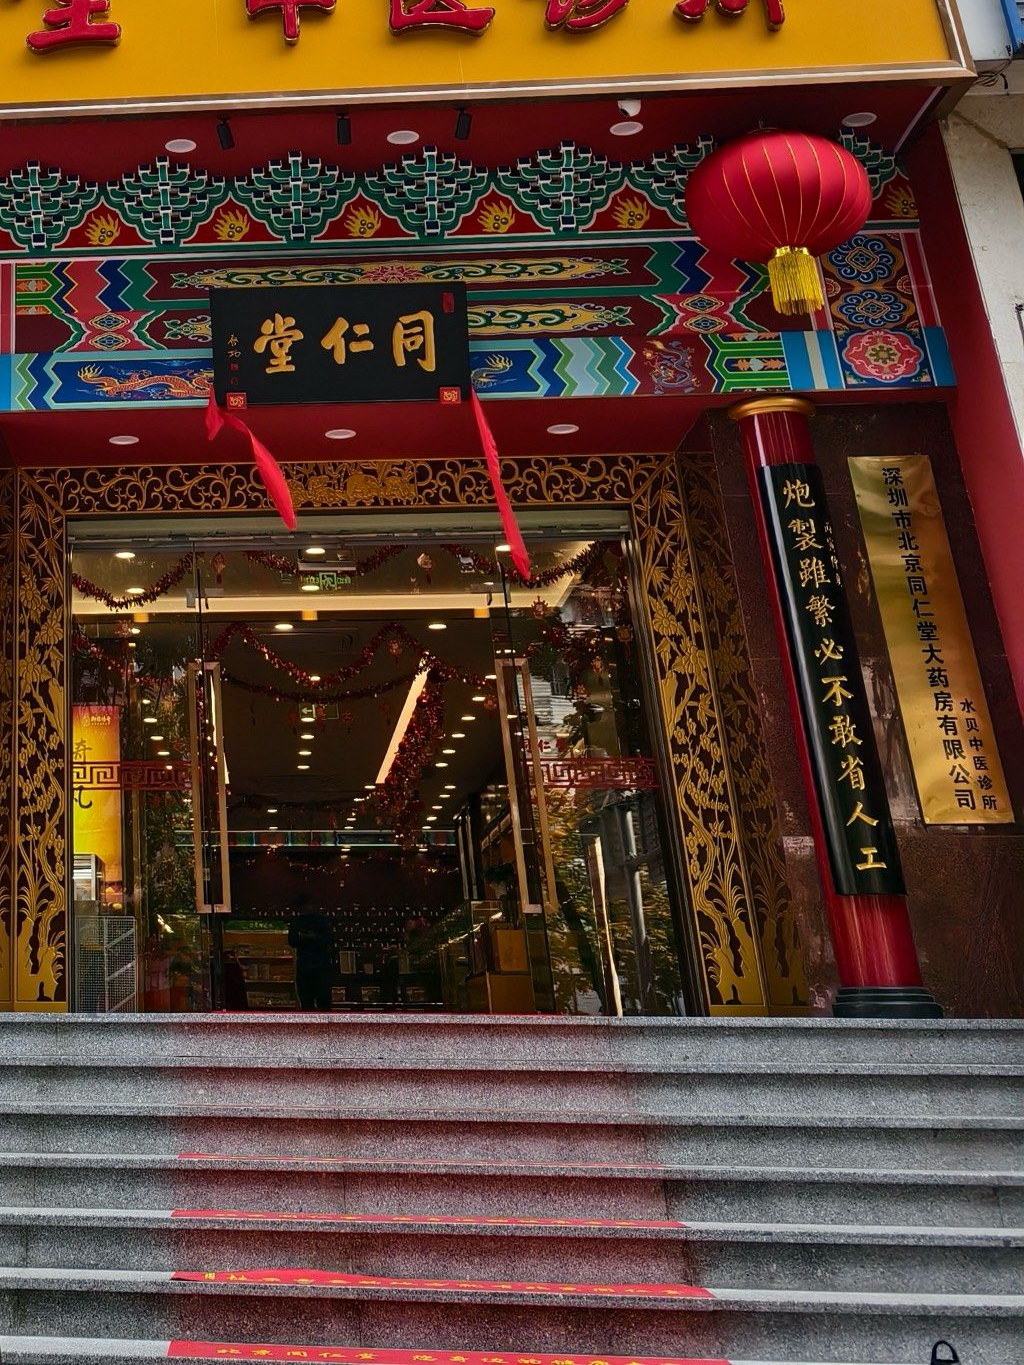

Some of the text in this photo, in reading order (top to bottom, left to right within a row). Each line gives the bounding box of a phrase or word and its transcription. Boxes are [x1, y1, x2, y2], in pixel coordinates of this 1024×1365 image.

[253, 310, 437, 374] 同仁堂
[881, 467, 977, 811] 深圳市北京同仁堂大药房有限公司
[960, 698, 998, 811] 水贝中医诊所
